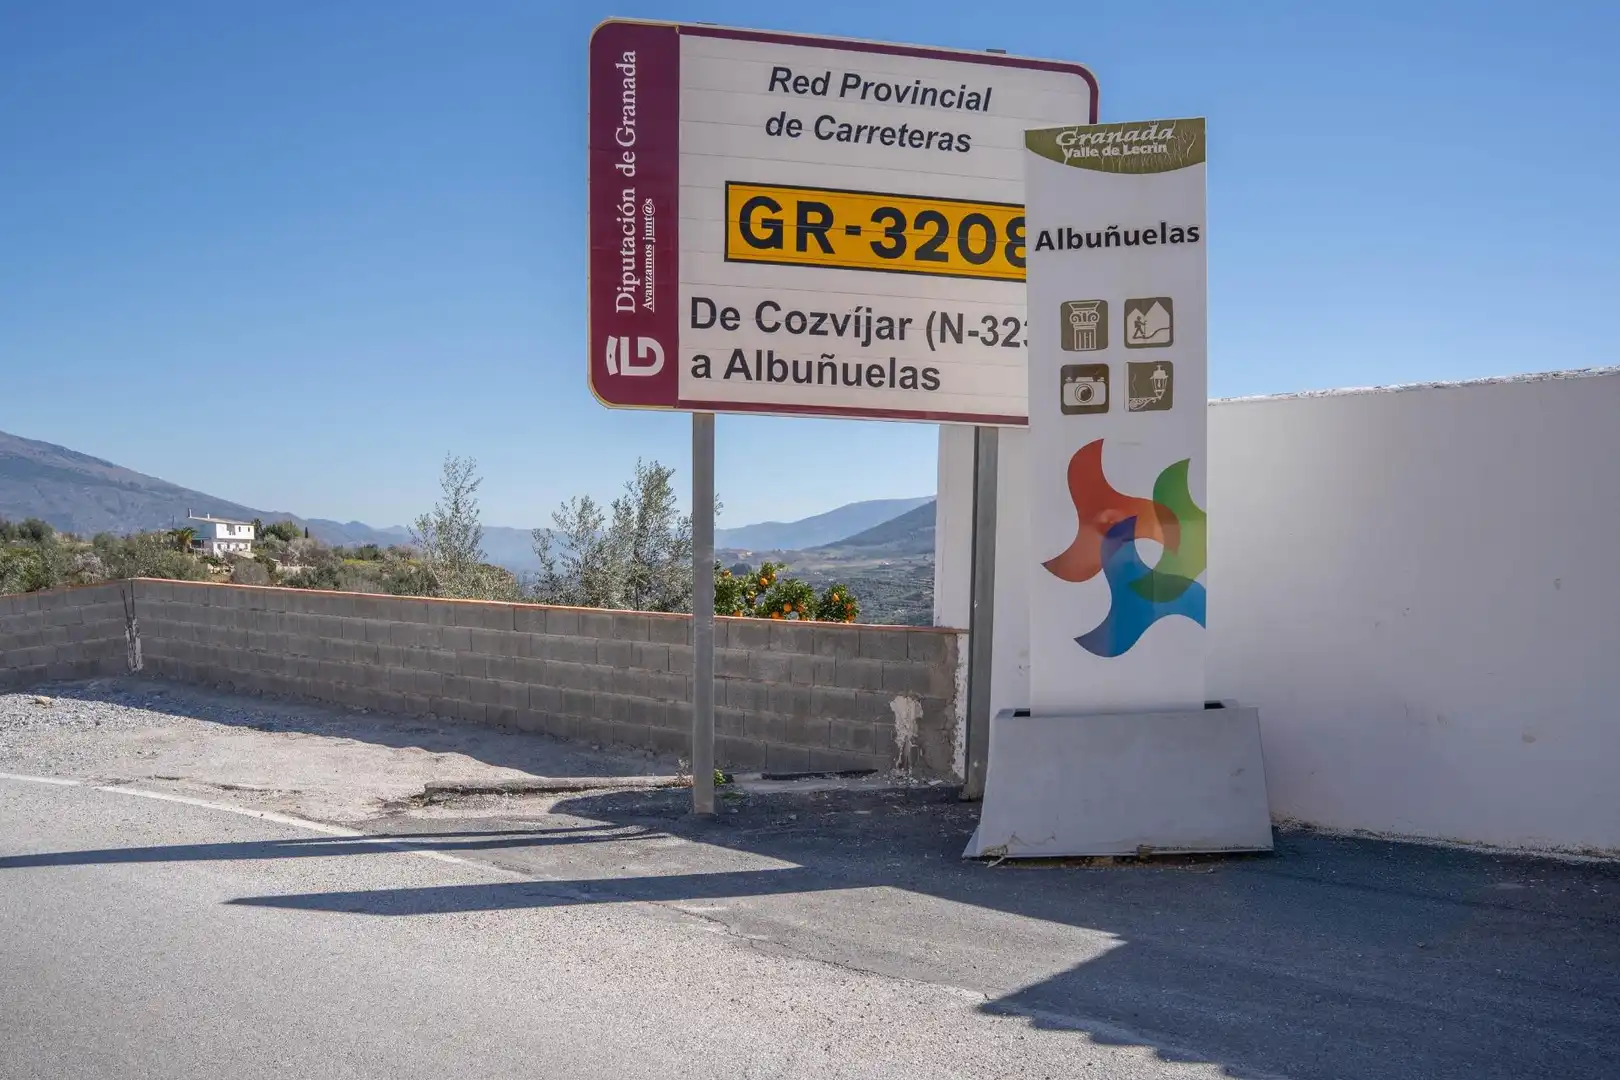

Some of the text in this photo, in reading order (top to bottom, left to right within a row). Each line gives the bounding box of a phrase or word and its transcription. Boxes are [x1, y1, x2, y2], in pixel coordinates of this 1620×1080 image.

[768, 66, 992, 112] Red Provincial
[765, 111, 972, 153] de Carreteras
[1056, 119, 1178, 146] Granada
[1063, 146, 1099, 158] Valle
[1102, 144, 1121, 156] de
[615, 50, 640, 313] Diputación de Granada
[739, 196, 1027, 268] GR-3208
[1035, 222, 1200, 251] Albuñuelas
[642, 198, 656, 312] Avanzamos junt@s
[690, 297, 1028, 351] De Cozvíjar (N-32
[690, 349, 941, 391] a Albuñuelas
